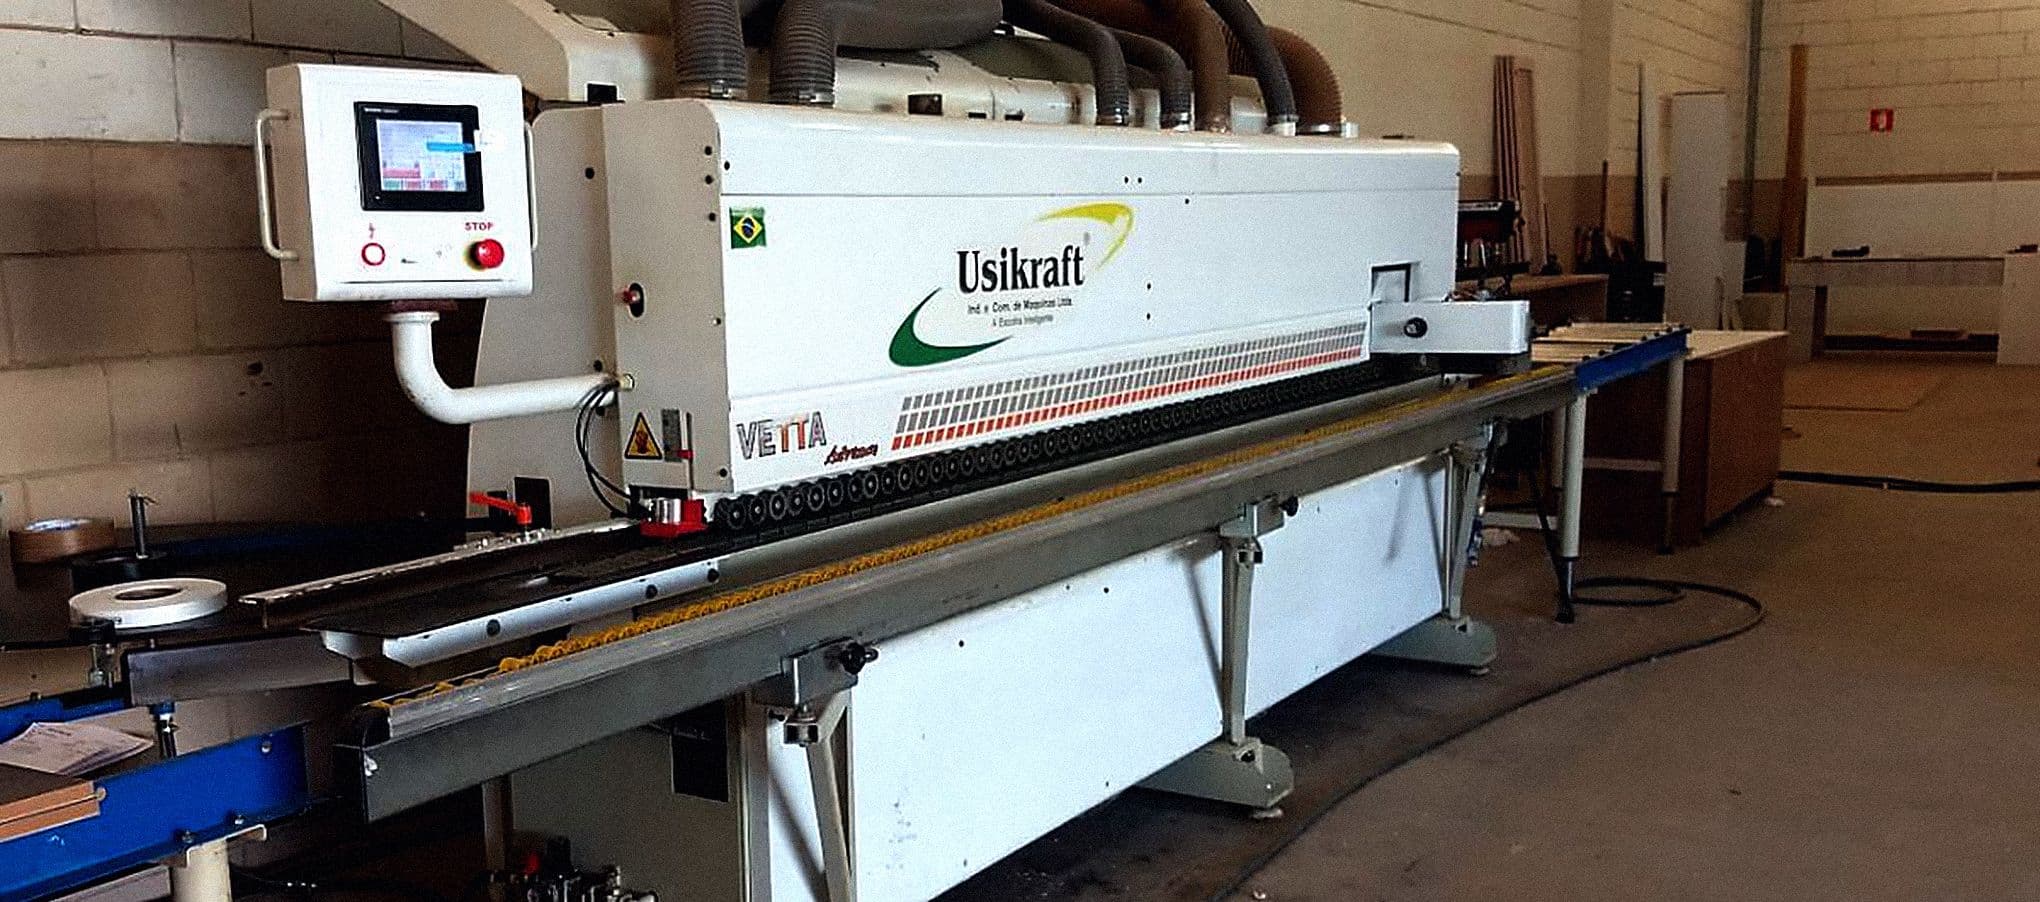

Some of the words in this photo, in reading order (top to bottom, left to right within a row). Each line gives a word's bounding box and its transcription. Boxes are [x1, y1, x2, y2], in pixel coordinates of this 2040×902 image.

[464, 221, 494, 231] STOP
[957, 245, 1085, 293] Usikraft
[736, 411, 827, 460] VETTA
